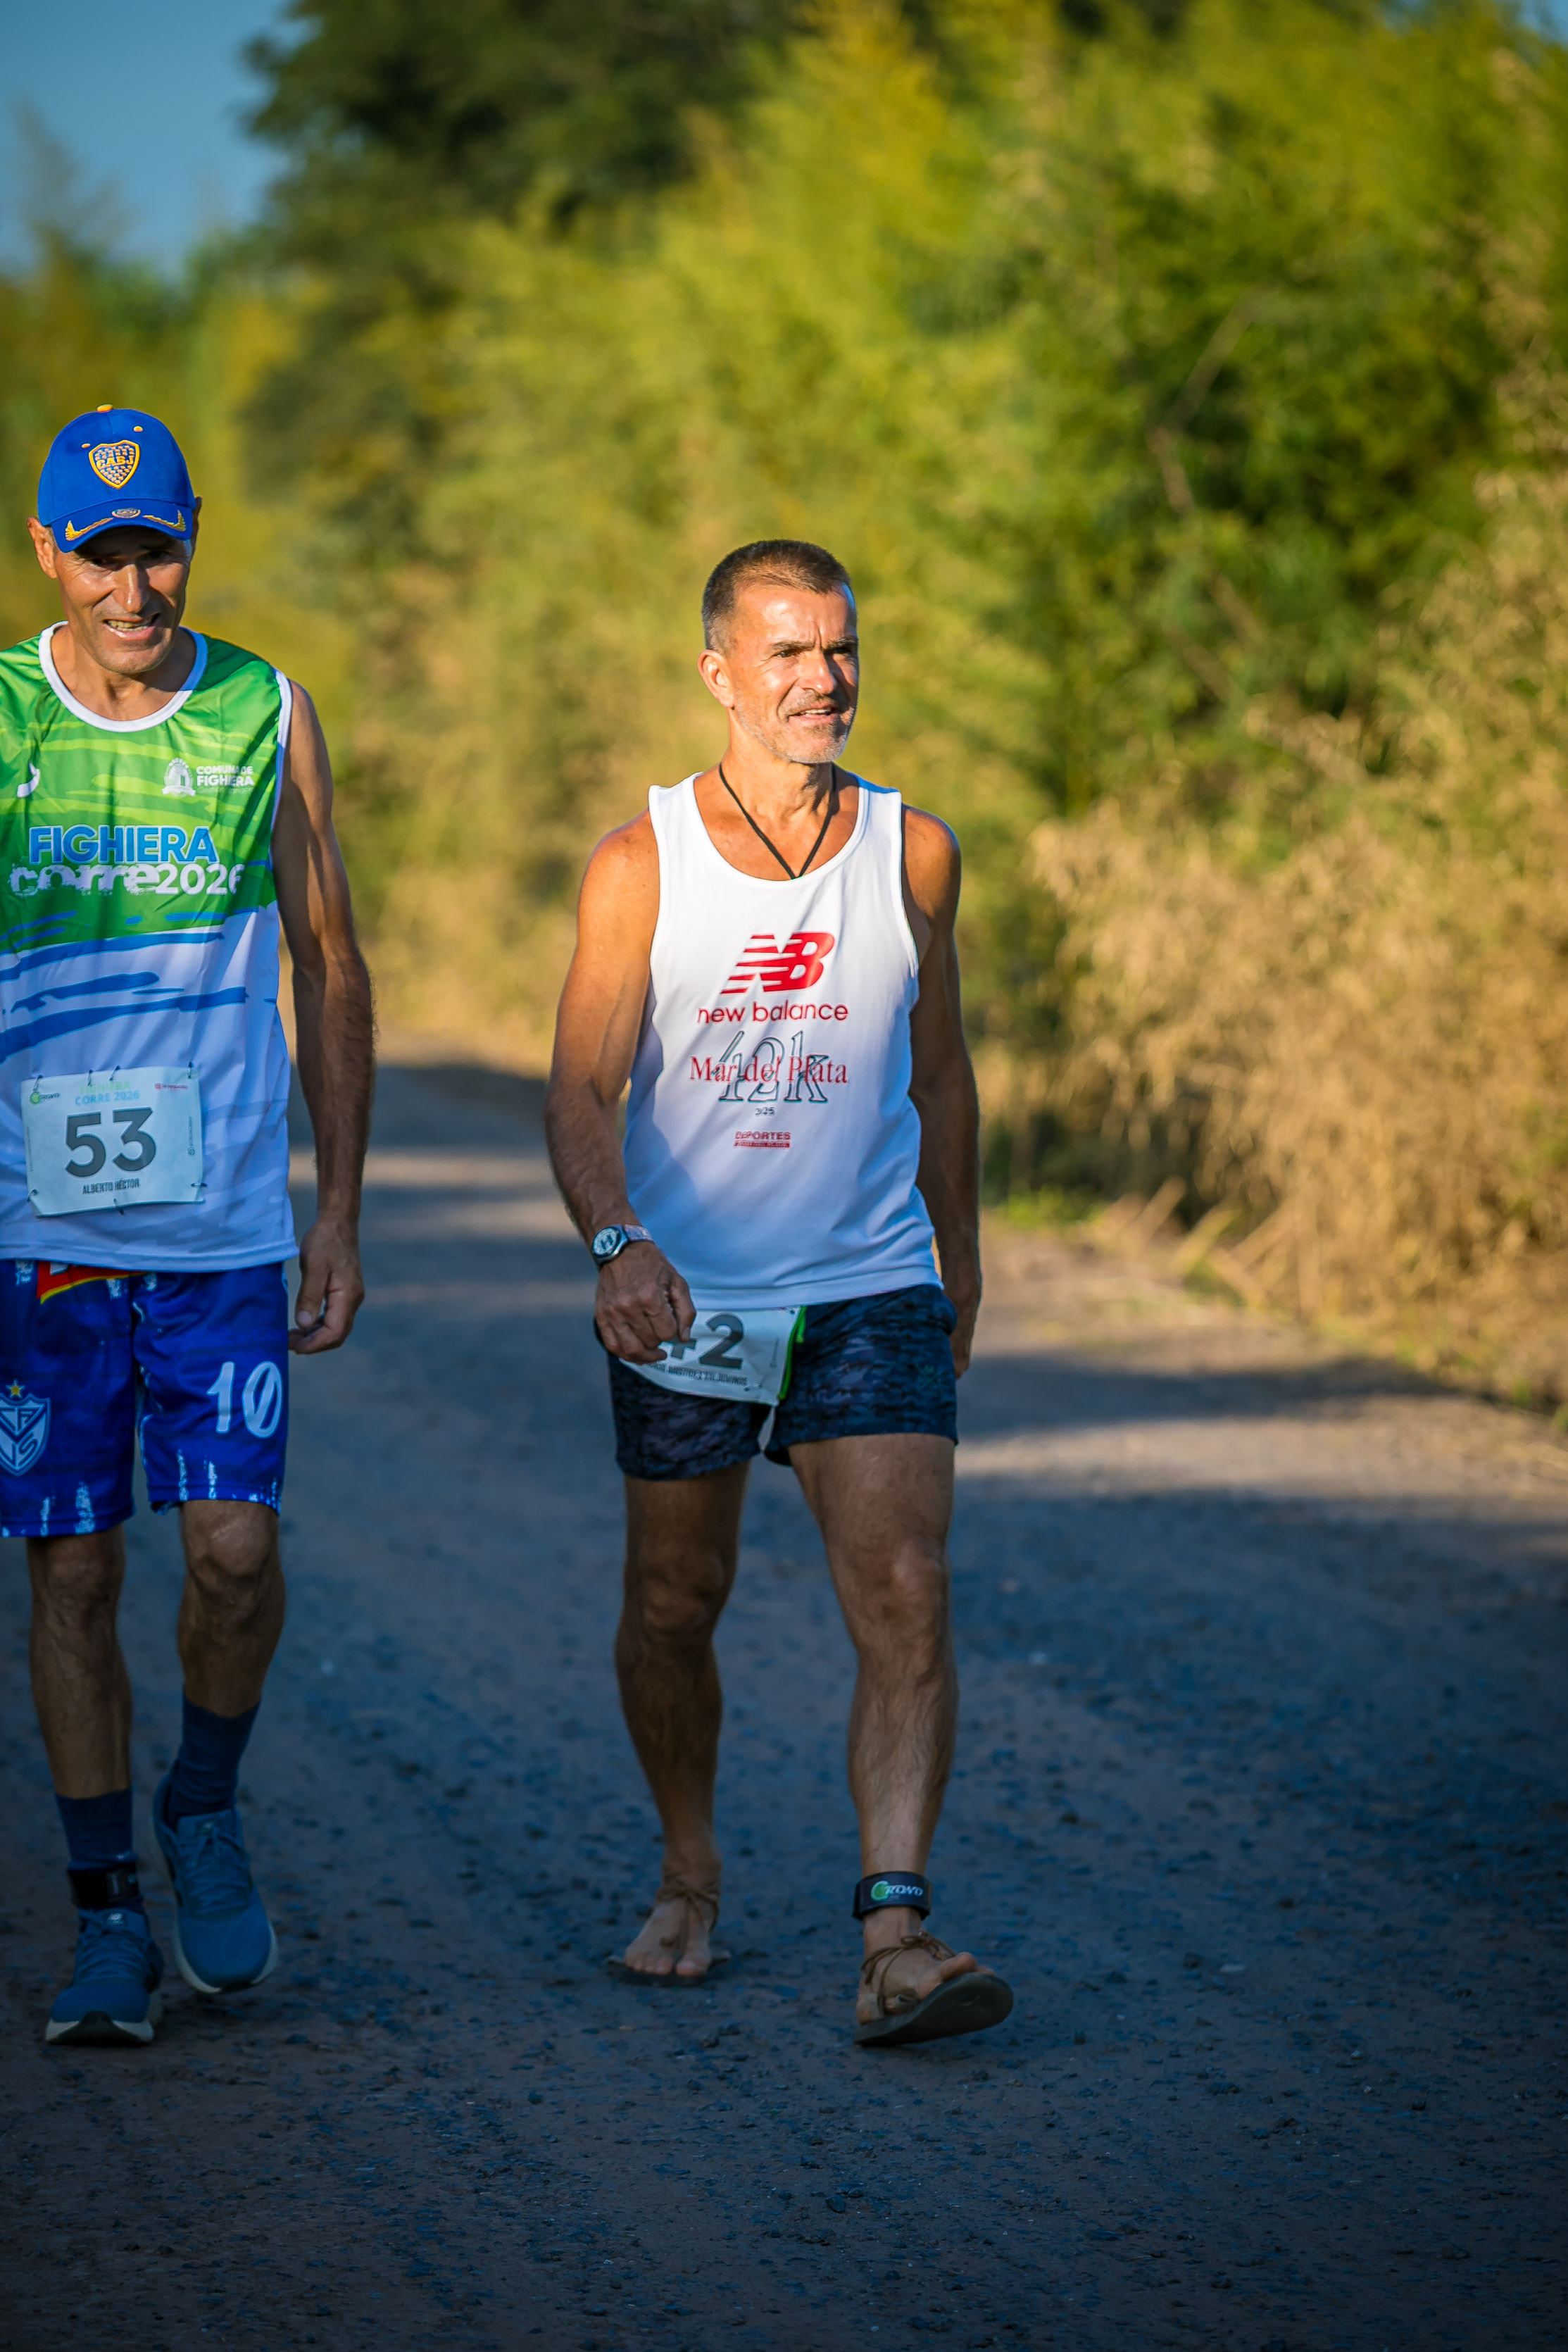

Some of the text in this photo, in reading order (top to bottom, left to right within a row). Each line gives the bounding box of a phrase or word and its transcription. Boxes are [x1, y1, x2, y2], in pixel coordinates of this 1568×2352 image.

[96, 455, 134, 470] CABJ
[30, 825, 219, 864] FIGHIERA
[697, 1000, 848, 1023] new balance
[689, 1056, 848, 1084] Mar del Plata
[75, 1092, 111, 1106] CORRE
[113, 1090, 140, 1101] 2026
[65, 1106, 156, 1177] 53
[735, 1131, 791, 1140] DEPORTES
[82, 1177, 139, 1194] ALBERTO HÉCTOR
[207, 1361, 282, 1439] 10
